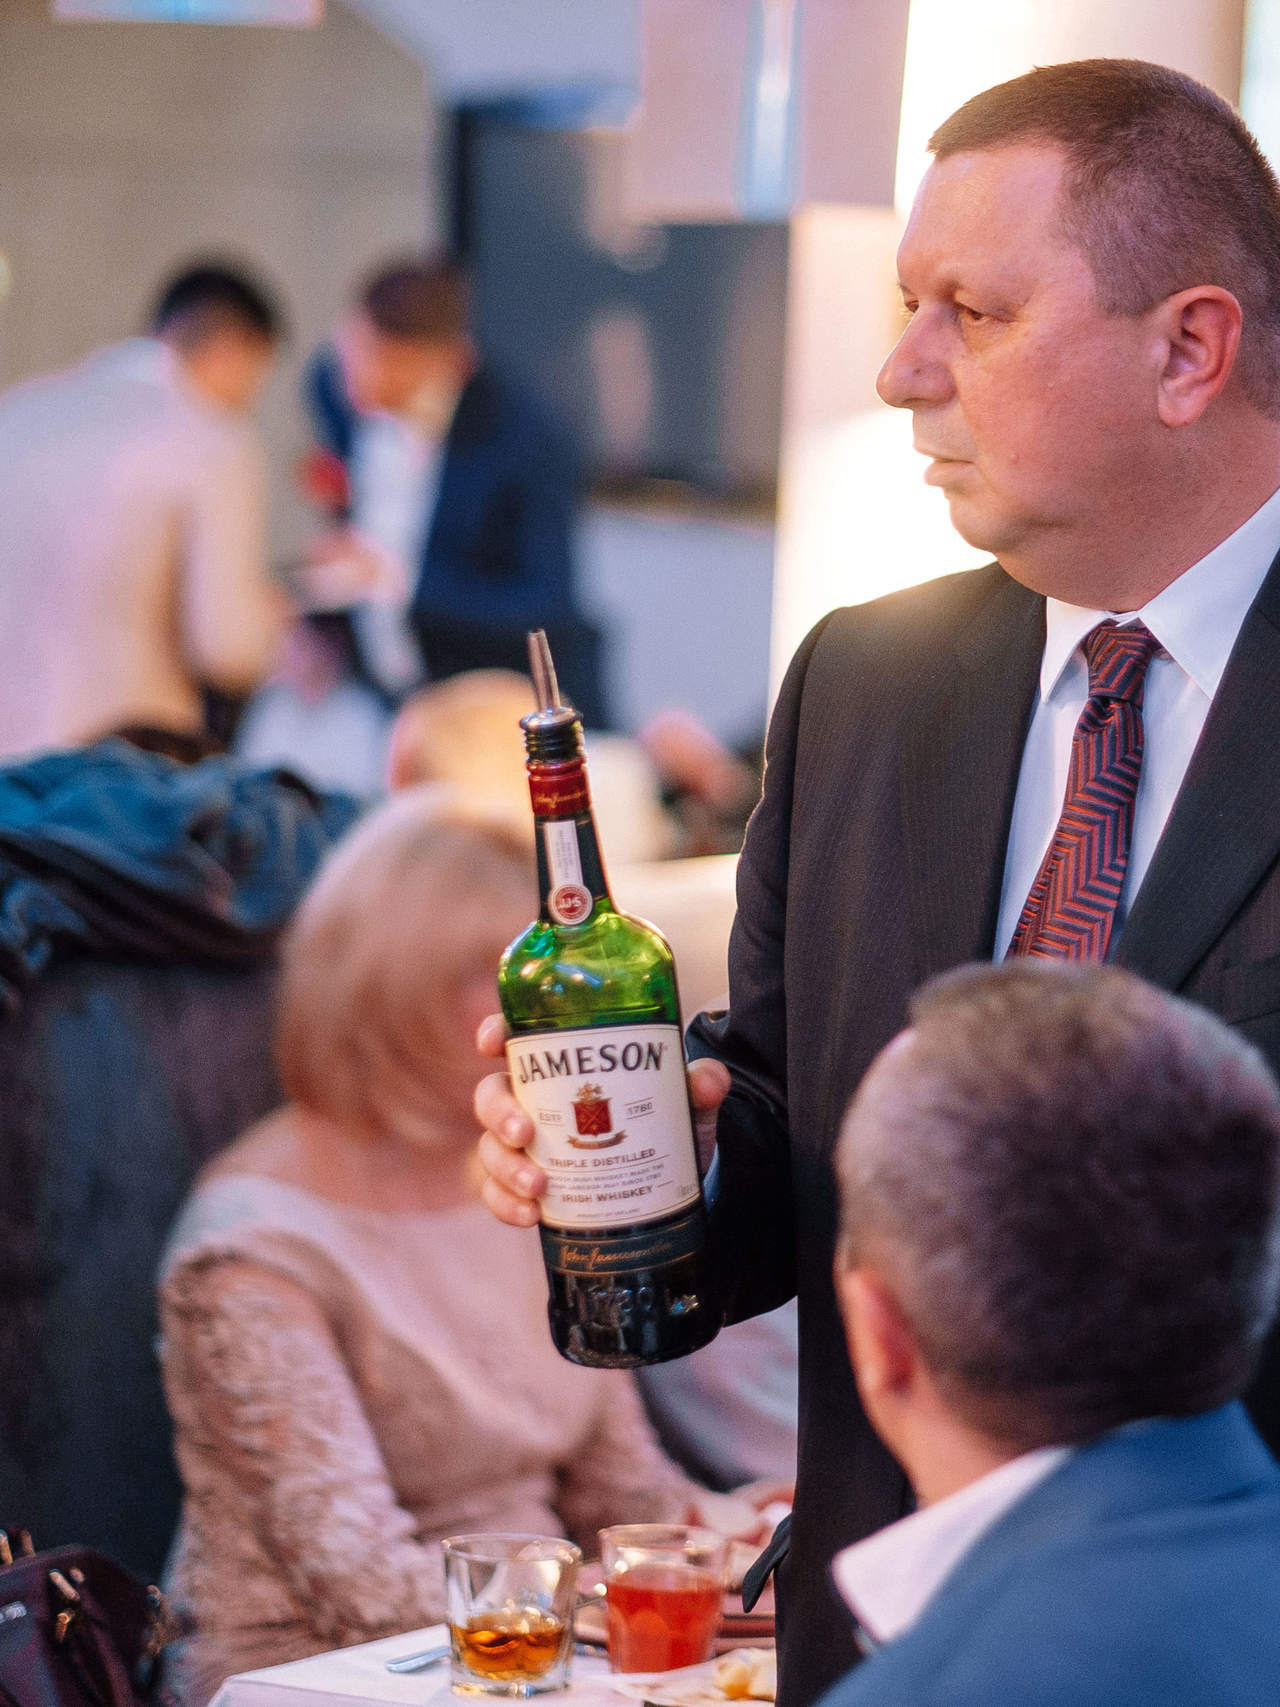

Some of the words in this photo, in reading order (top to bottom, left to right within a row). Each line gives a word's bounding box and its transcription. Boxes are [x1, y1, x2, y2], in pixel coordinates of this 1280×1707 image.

[519, 1041, 664, 1084] JAMESON
[627, 1101, 653, 1116] 1780
[549, 1157, 588, 1168] TRIPLE
[592, 1148, 656, 1168] DISTILLED
[562, 1194, 592, 1203] IRISH
[597, 1185, 653, 1202] WHISKEY
